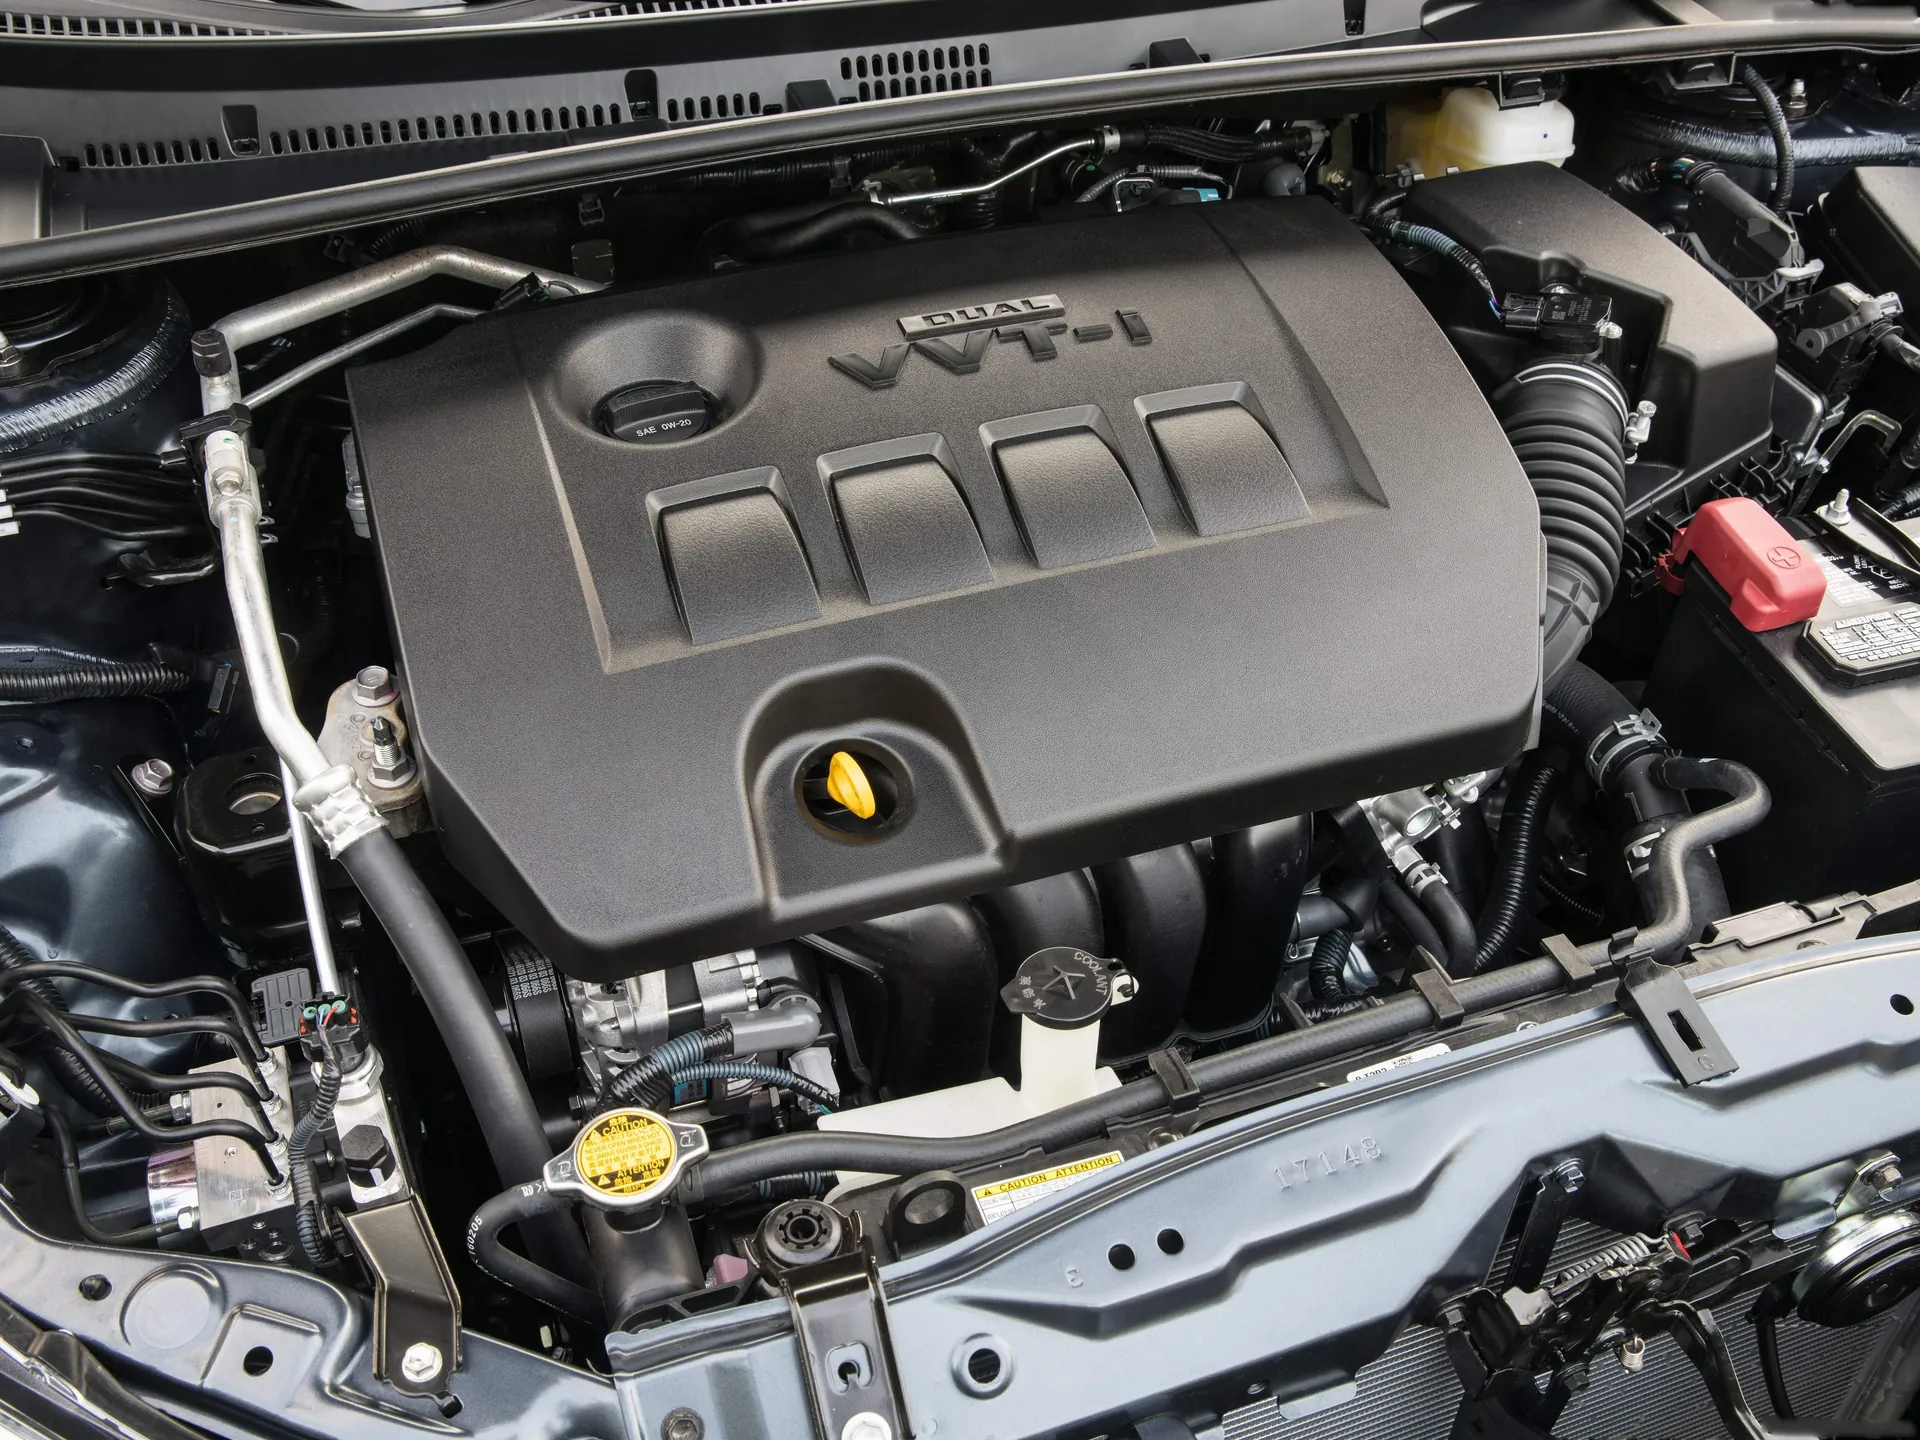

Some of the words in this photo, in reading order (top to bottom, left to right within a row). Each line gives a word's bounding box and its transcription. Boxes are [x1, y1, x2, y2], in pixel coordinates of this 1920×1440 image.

[921, 299, 1051, 327] DUAL
[636, 426, 657, 437] SAE
[661, 418, 692, 431] 0W-20
[1073, 951, 1108, 996] COOLANT
[602, 1118, 648, 1136] CAUTION
[585, 1145, 606, 1154] NEVER
[608, 1140, 626, 1149] OPEN
[627, 1135, 646, 1144] WHEN
[647, 1131, 660, 1139] HOT
[617, 1159, 665, 1178] ATTENTION
[999, 1174, 1047, 1193] CAUTION
[1055, 1156, 1114, 1178] ATTENTION
[1273, 1136, 1382, 1190] 17148
[467, 1215, 483, 1255] 160205
